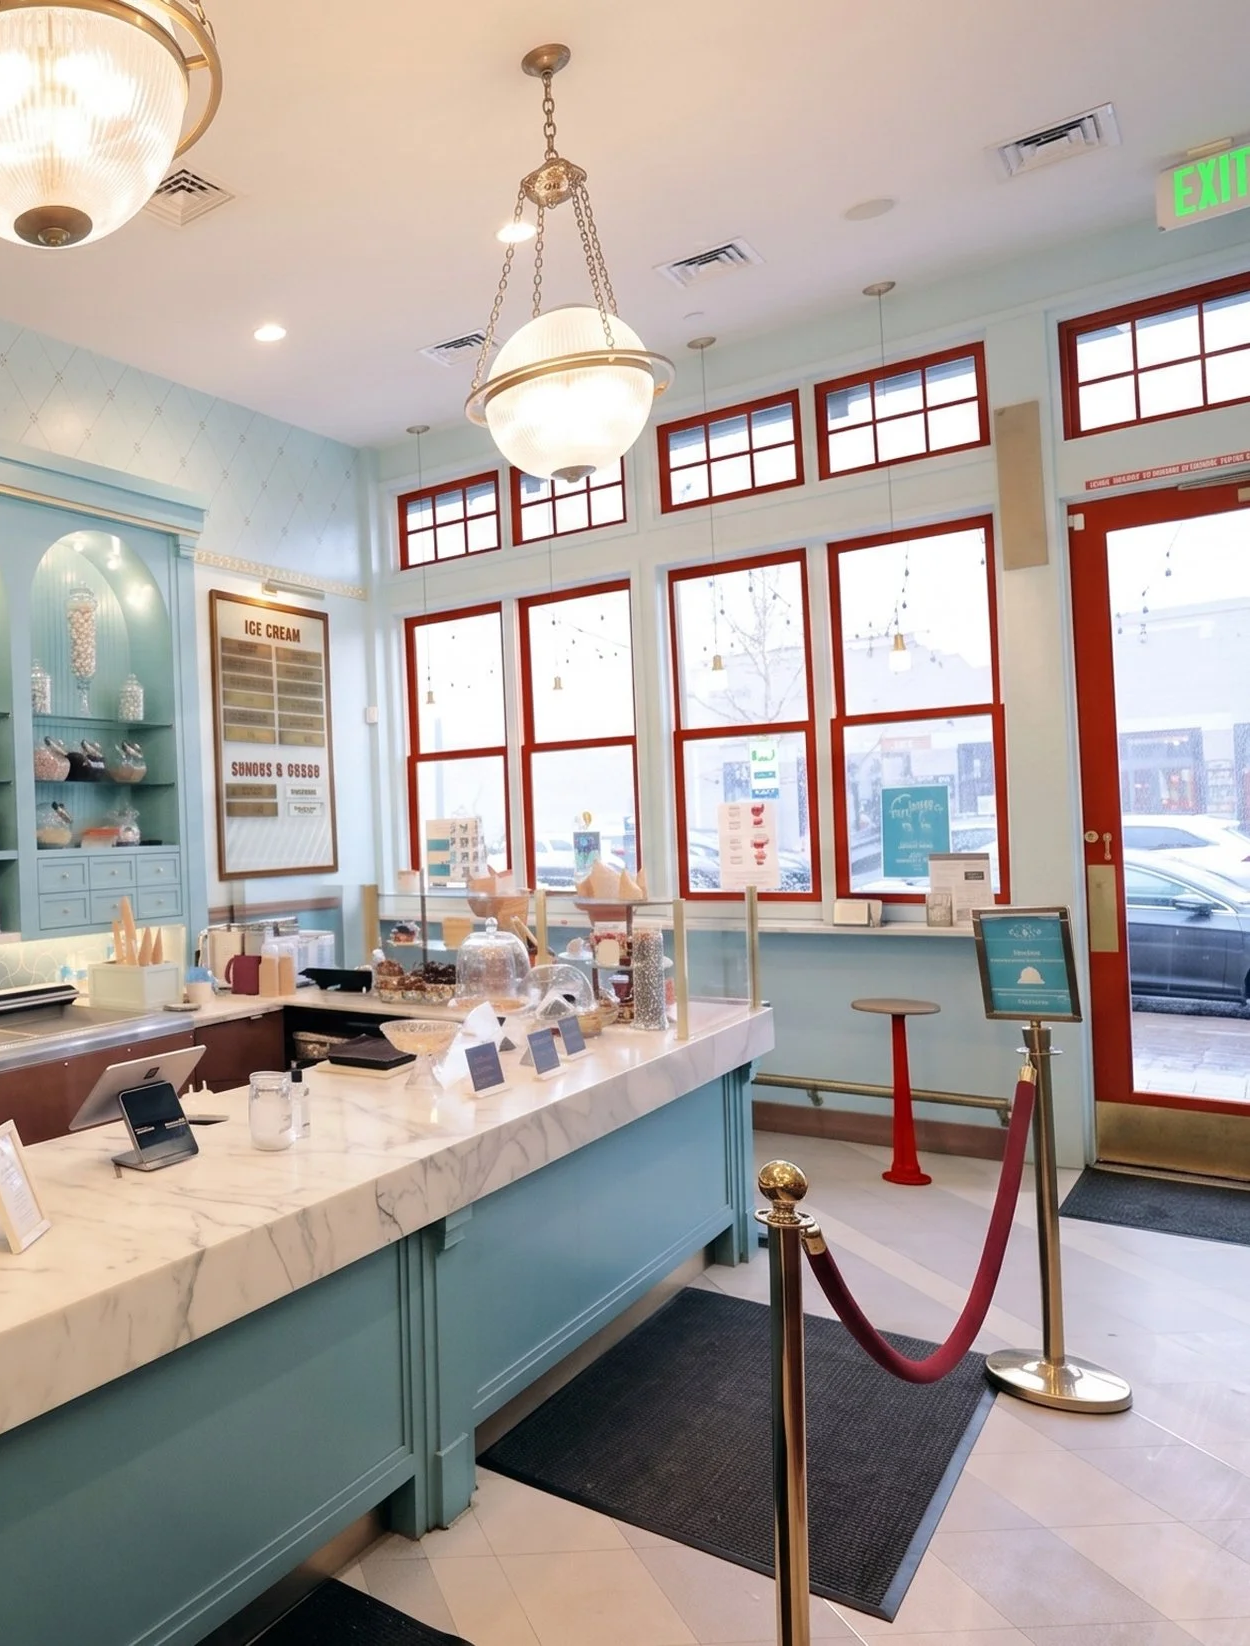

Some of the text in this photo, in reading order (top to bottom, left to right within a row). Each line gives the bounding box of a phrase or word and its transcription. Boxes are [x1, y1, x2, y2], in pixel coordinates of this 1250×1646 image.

[1173, 145, 1250, 217] EXIT
[244, 619, 301, 643] ICE CREAM
